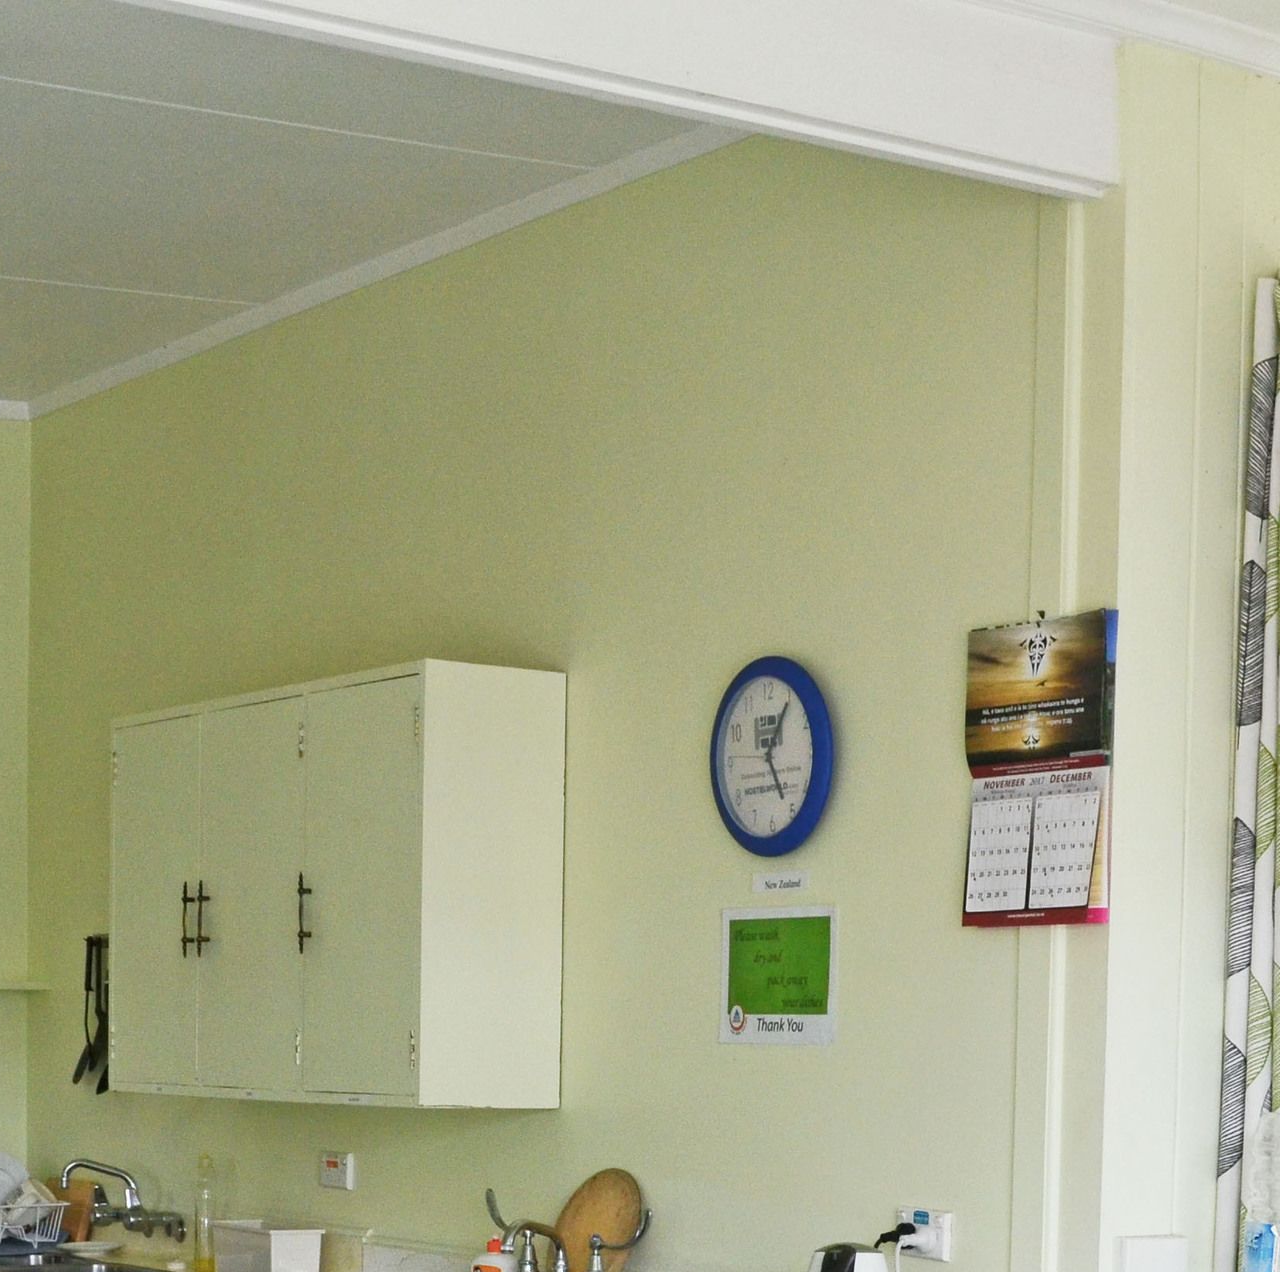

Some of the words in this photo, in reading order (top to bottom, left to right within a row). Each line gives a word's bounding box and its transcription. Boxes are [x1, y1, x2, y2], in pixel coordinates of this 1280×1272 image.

[763, 682, 774, 701] 12
[744, 695, 754, 714] 11
[731, 723, 742, 743] 10
[983, 778, 1026, 790] NOVEMBER
[1049, 771, 1093, 784] DECEMBER
[752, 809, 758, 828] 7
[789, 803, 796, 820] 5
[770, 814, 776, 833] 6
[764, 880, 778, 889] New
[778, 879, 801, 889] Zealand
[757, 1017, 785, 1033] Thank
[787, 1018, 804, 1033] You
